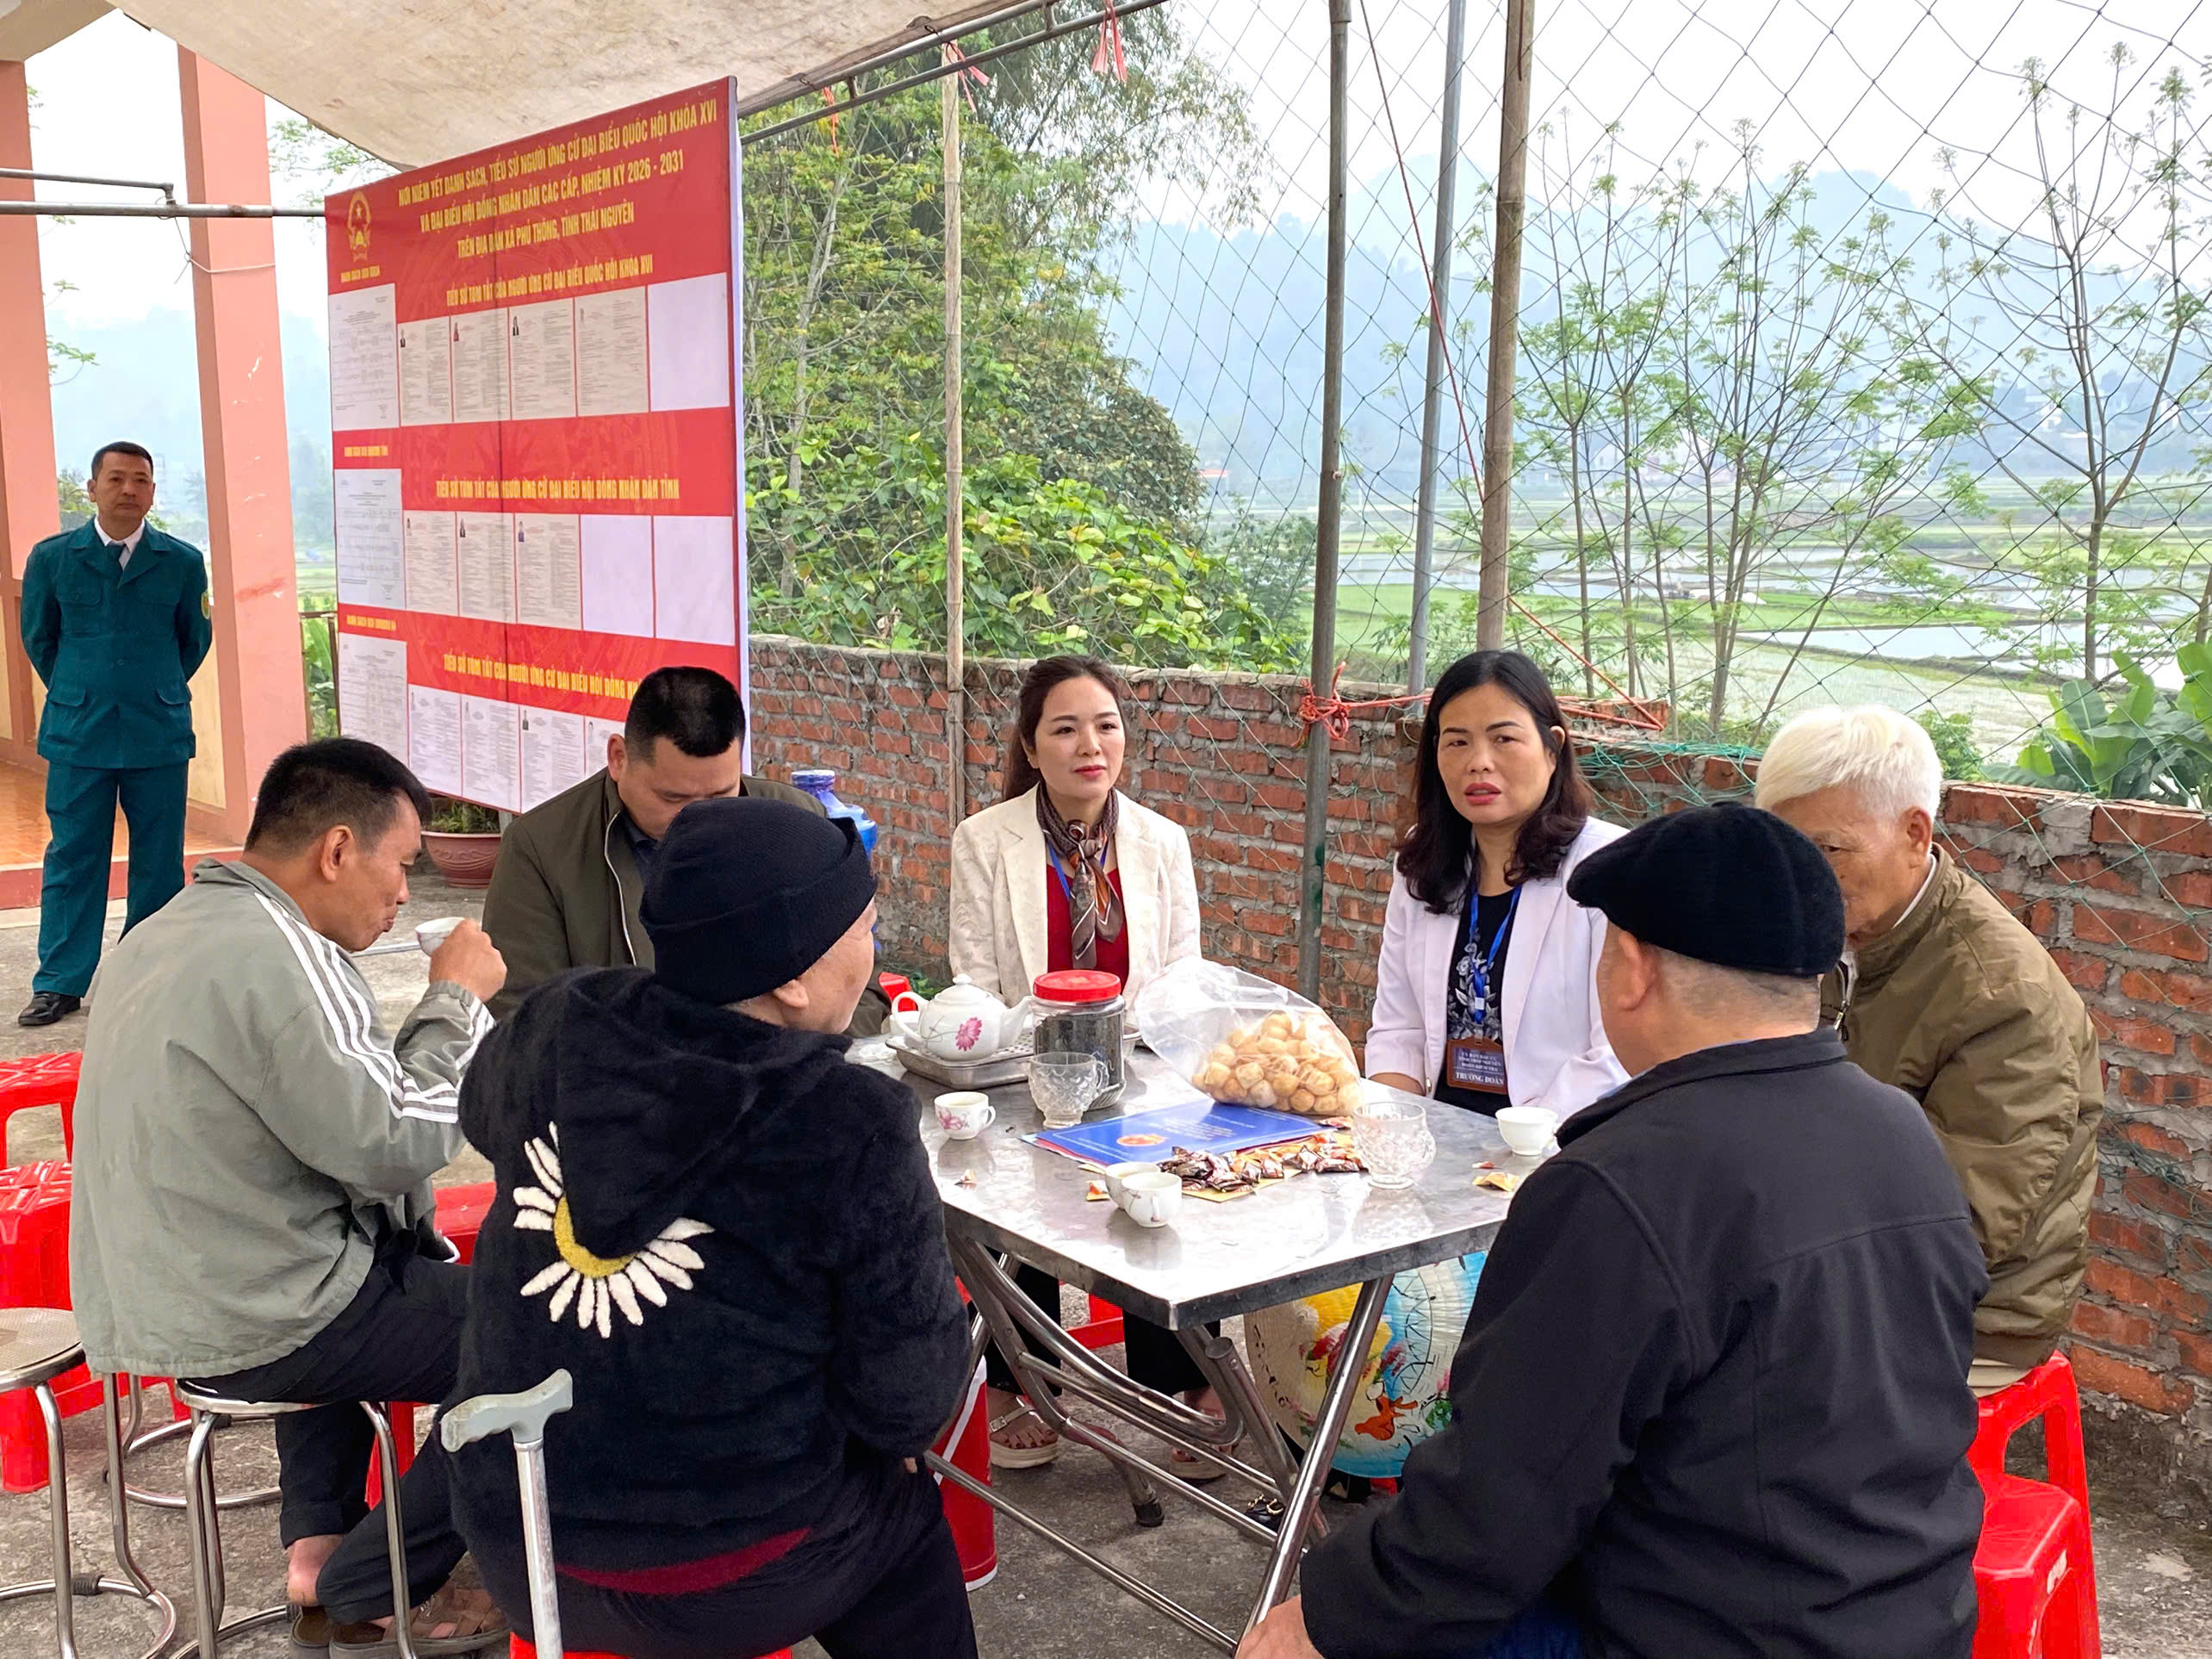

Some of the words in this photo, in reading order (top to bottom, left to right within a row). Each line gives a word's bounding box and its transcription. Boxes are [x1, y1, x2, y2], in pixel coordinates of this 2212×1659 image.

[445, 172, 464, 195] DANH
[489, 153, 506, 183] TIỂU
[508, 151, 519, 179] SỬ
[521, 145, 546, 175] NGƯỜI
[548, 142, 566, 167] ỨNG
[568, 133, 580, 161] CỬ
[581, 135, 597, 161] ĐẠI
[600, 120, 620, 153] BIỂU
[623, 113, 648, 148] QUỐC
[651, 110, 668, 141] HỘI
[670, 103, 697, 133] KHÓA
[700, 98, 717, 124] XVI
[420, 211, 430, 233] VÀ
[432, 209, 444, 233] ĐẠI
[444, 199, 461, 227] BIỂU
[462, 199, 475, 226] HỘI
[476, 193, 497, 221] ĐỒNG
[499, 189, 521, 214] NHÂN
[523, 183, 540, 209] DÂN
[542, 178, 558, 204] CÁC
[561, 169, 580, 199] CẤP,
[581, 165, 611, 196] NHIỆM
[613, 158, 625, 186] KỲ
[627, 158, 650, 183] 2026
[660, 148, 684, 176] 2031
[457, 234, 475, 258] TRÊN
[561, 208, 579, 237] TỈNH
[581, 205, 599, 233] THÁI
[600, 197, 634, 229] NGUYÊN
[584, 256, 603, 284] QUỐC
[605, 257, 618, 283] HỘI
[640, 253, 653, 275] XVI
[486, 475, 499, 498] CỦA
[501, 476, 520, 499] NGƯỜI
[522, 476, 536, 499] ỨNG
[537, 475, 547, 499] CỬ
[549, 479, 562, 503] ĐẠI
[562, 472, 579, 499] BIỂU
[581, 475, 593, 503] HỘI
[595, 472, 617, 499] ĐỒNG
[618, 475, 639, 500] NHÂN
[642, 475, 658, 499] DÂN
[660, 473, 680, 500] TỈNH
[444, 648, 457, 671] TIỂU
[457, 651, 467, 674] SỬ
[467, 656, 481, 675] TÓM
[482, 655, 493, 678] TẮT
[494, 656, 506, 680] CỦA
[507, 662, 530, 683] NGƯỜI
[531, 663, 544, 687] ỨNG
[545, 664, 556, 688] CỬ
[557, 670, 569, 694] ĐẠI
[571, 665, 587, 693] BIỂU
[589, 671, 602, 699] HỘI
[604, 670, 625, 699] ĐỒNG
